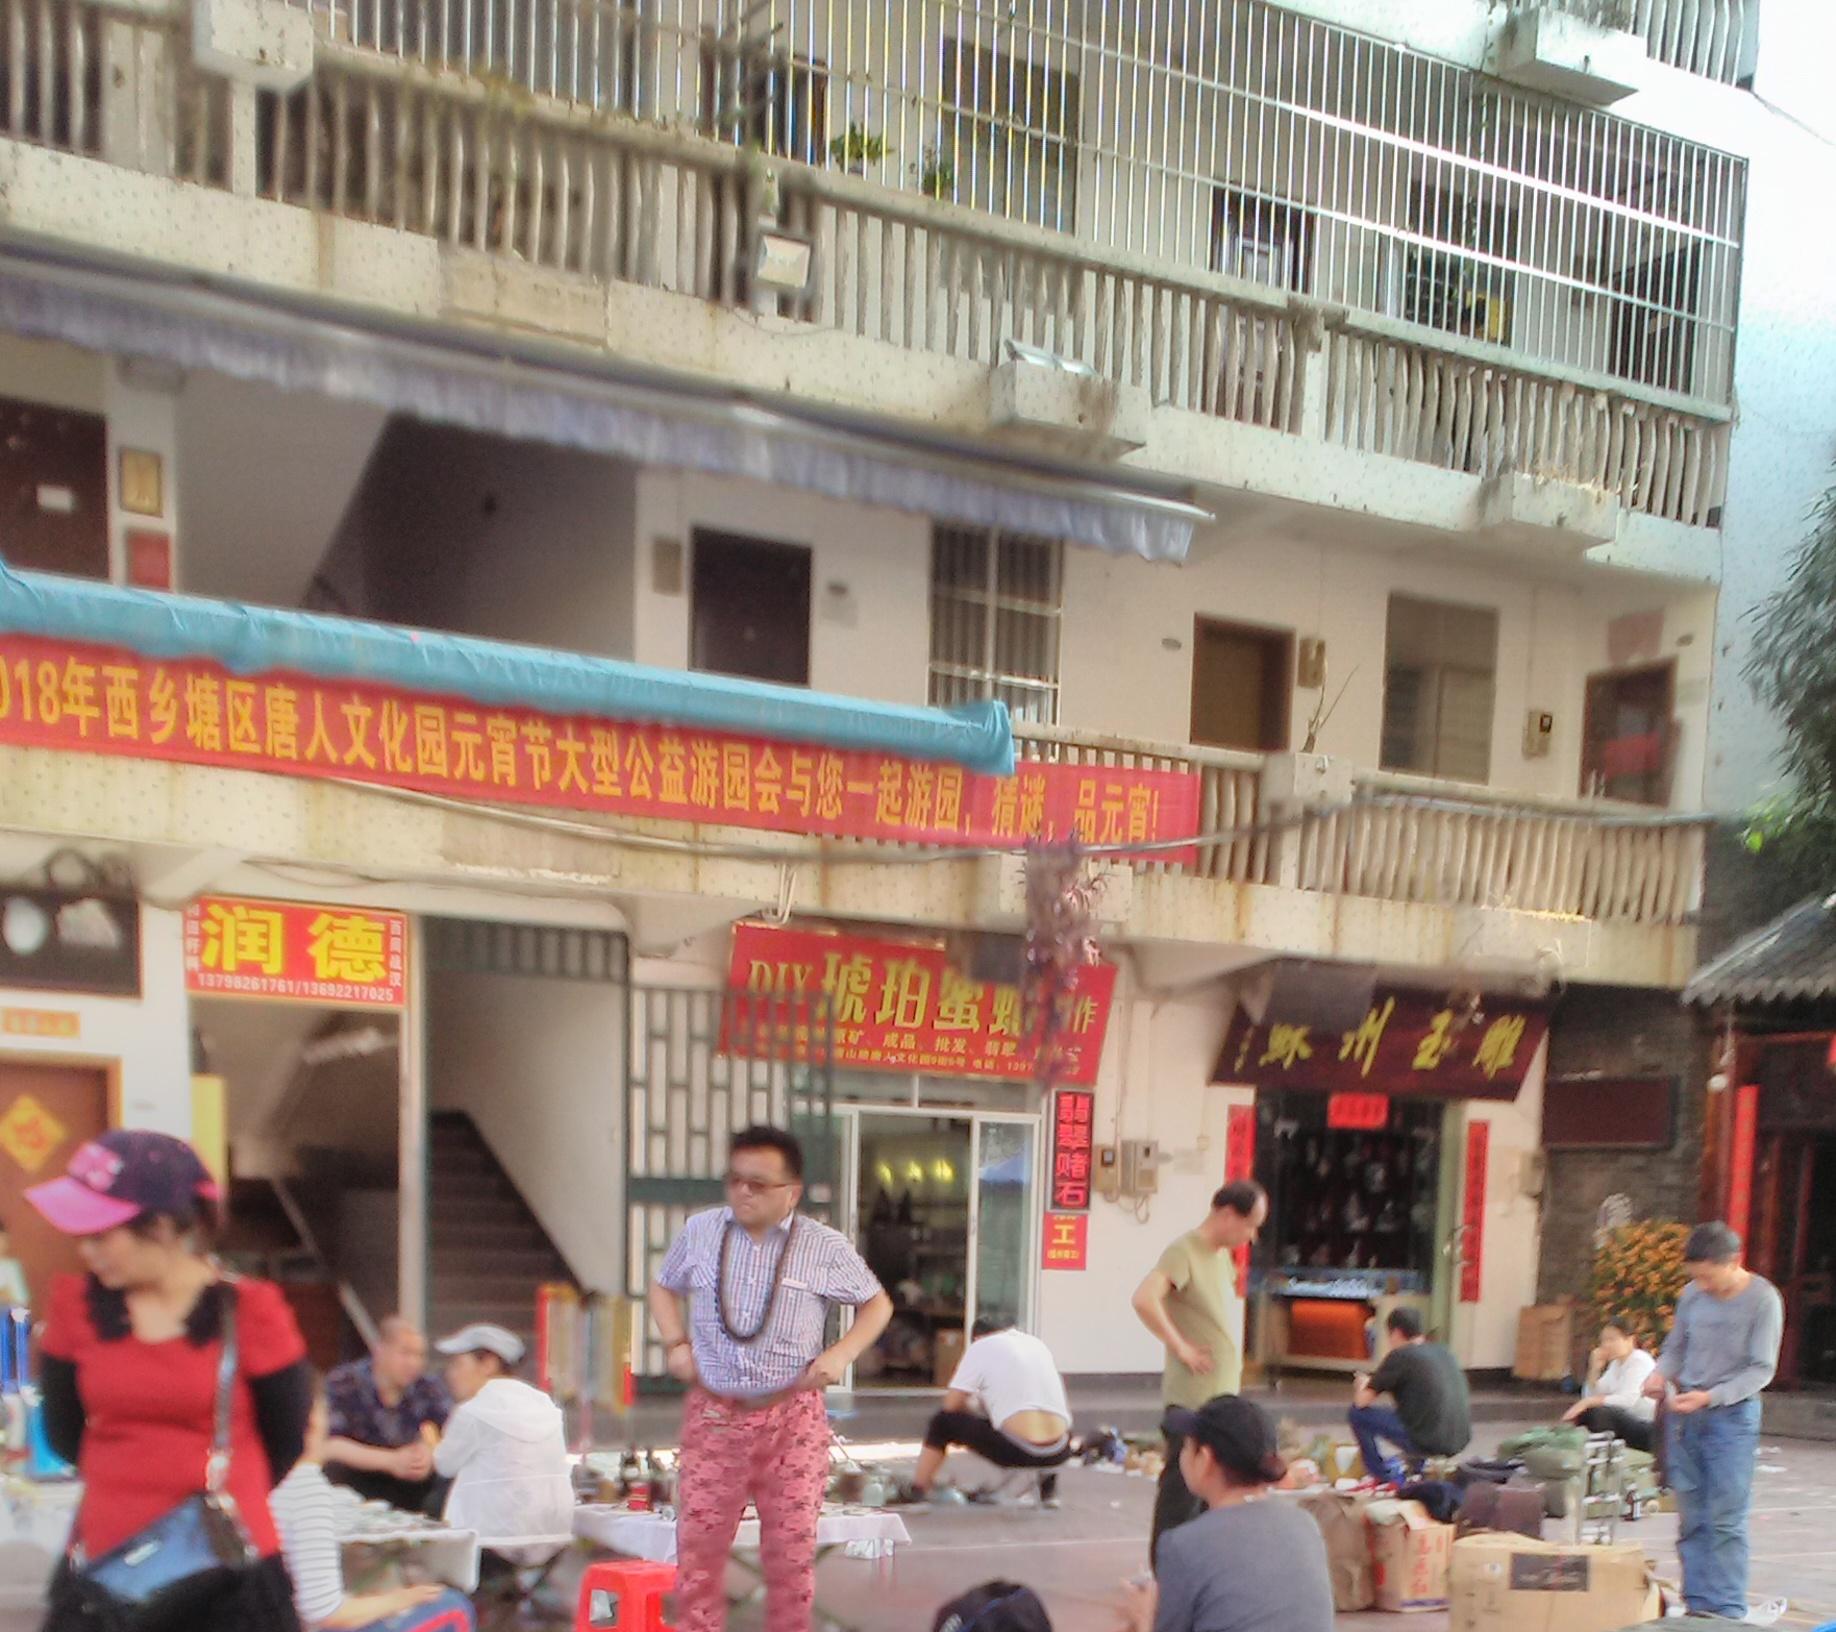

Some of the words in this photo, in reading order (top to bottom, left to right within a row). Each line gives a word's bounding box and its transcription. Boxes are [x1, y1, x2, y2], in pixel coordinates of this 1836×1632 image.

[201, 903, 387, 982] 润德
[1055, 1095, 1090, 1207] 翡翠赌石
